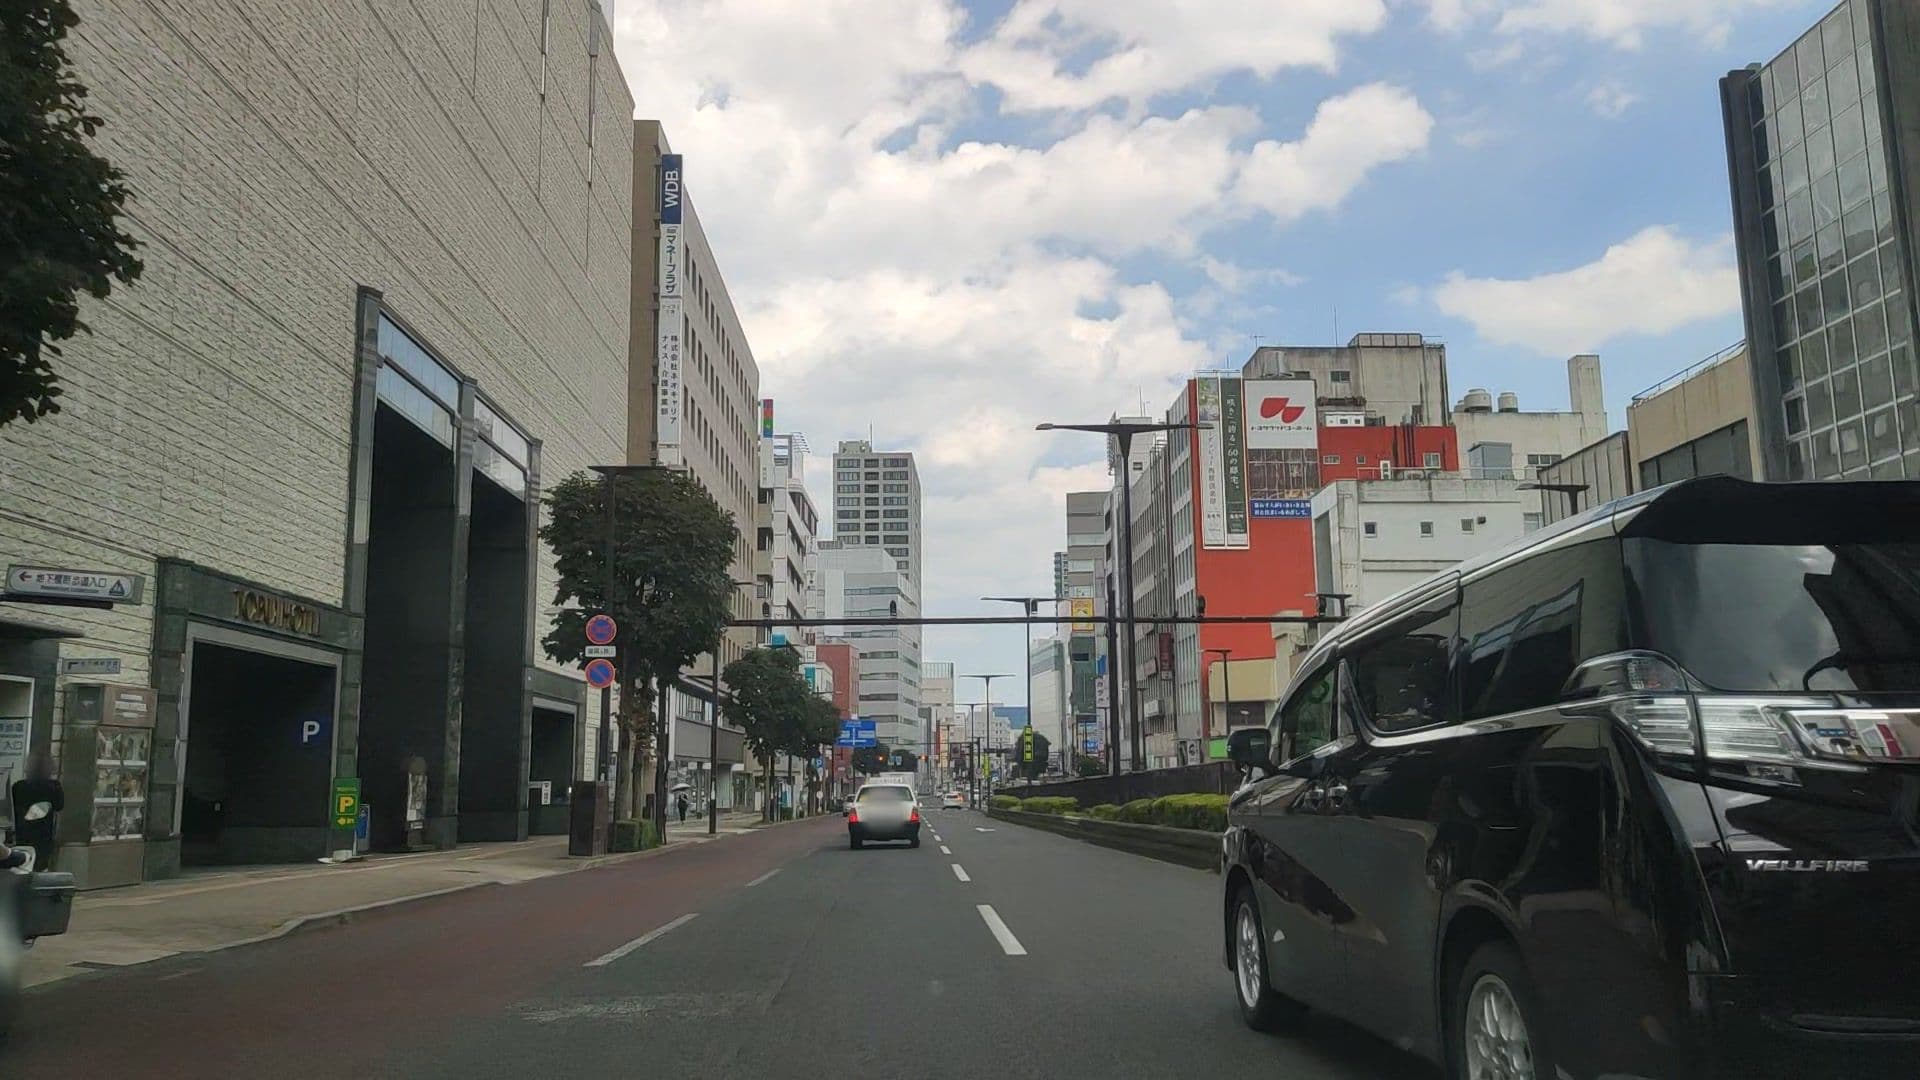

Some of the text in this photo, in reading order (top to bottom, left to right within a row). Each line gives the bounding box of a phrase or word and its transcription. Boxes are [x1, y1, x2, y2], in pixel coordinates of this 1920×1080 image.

[664, 169, 679, 208] WDB
[302, 720, 320, 743] P
[339, 796, 354, 813] P
[1746, 859, 1869, 872] VELLFIRE
